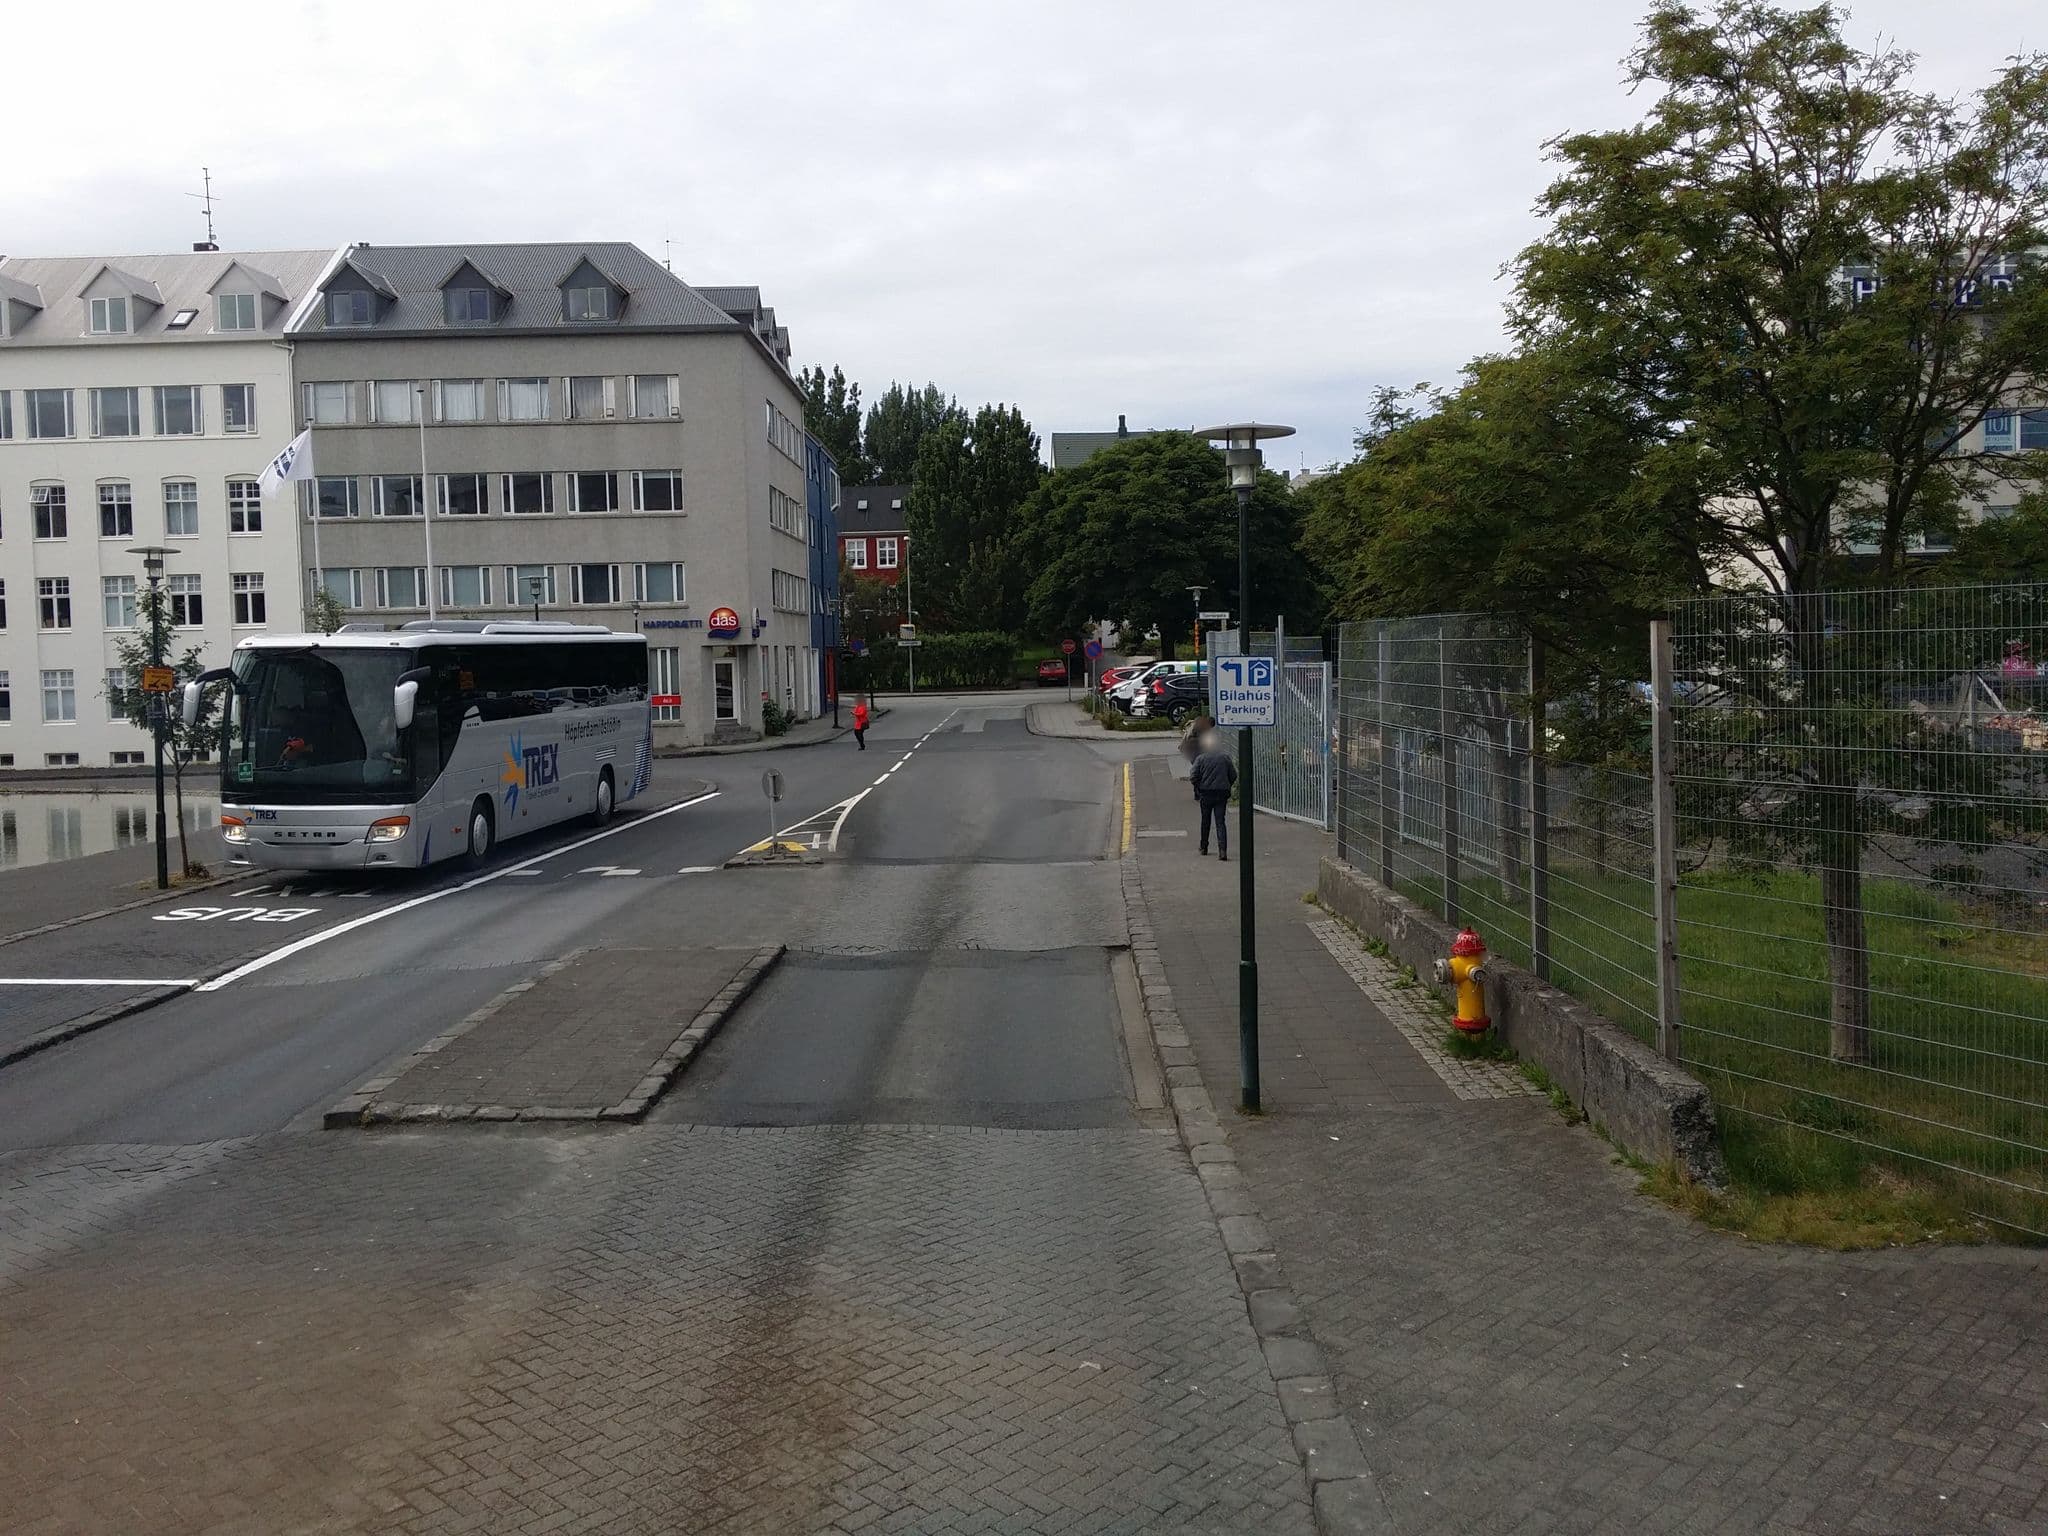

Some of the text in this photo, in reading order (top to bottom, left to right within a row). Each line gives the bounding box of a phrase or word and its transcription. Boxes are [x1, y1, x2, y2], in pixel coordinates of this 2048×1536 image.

[710, 614, 737, 627] das
[1253, 667, 1267, 685] P
[1219, 689, 1271, 701] Bílahús
[1224, 705, 1266, 715] Parking
[522, 742, 560, 789] TREX
[255, 809, 277, 820] TREX
[151, 907, 322, 922] BUS
